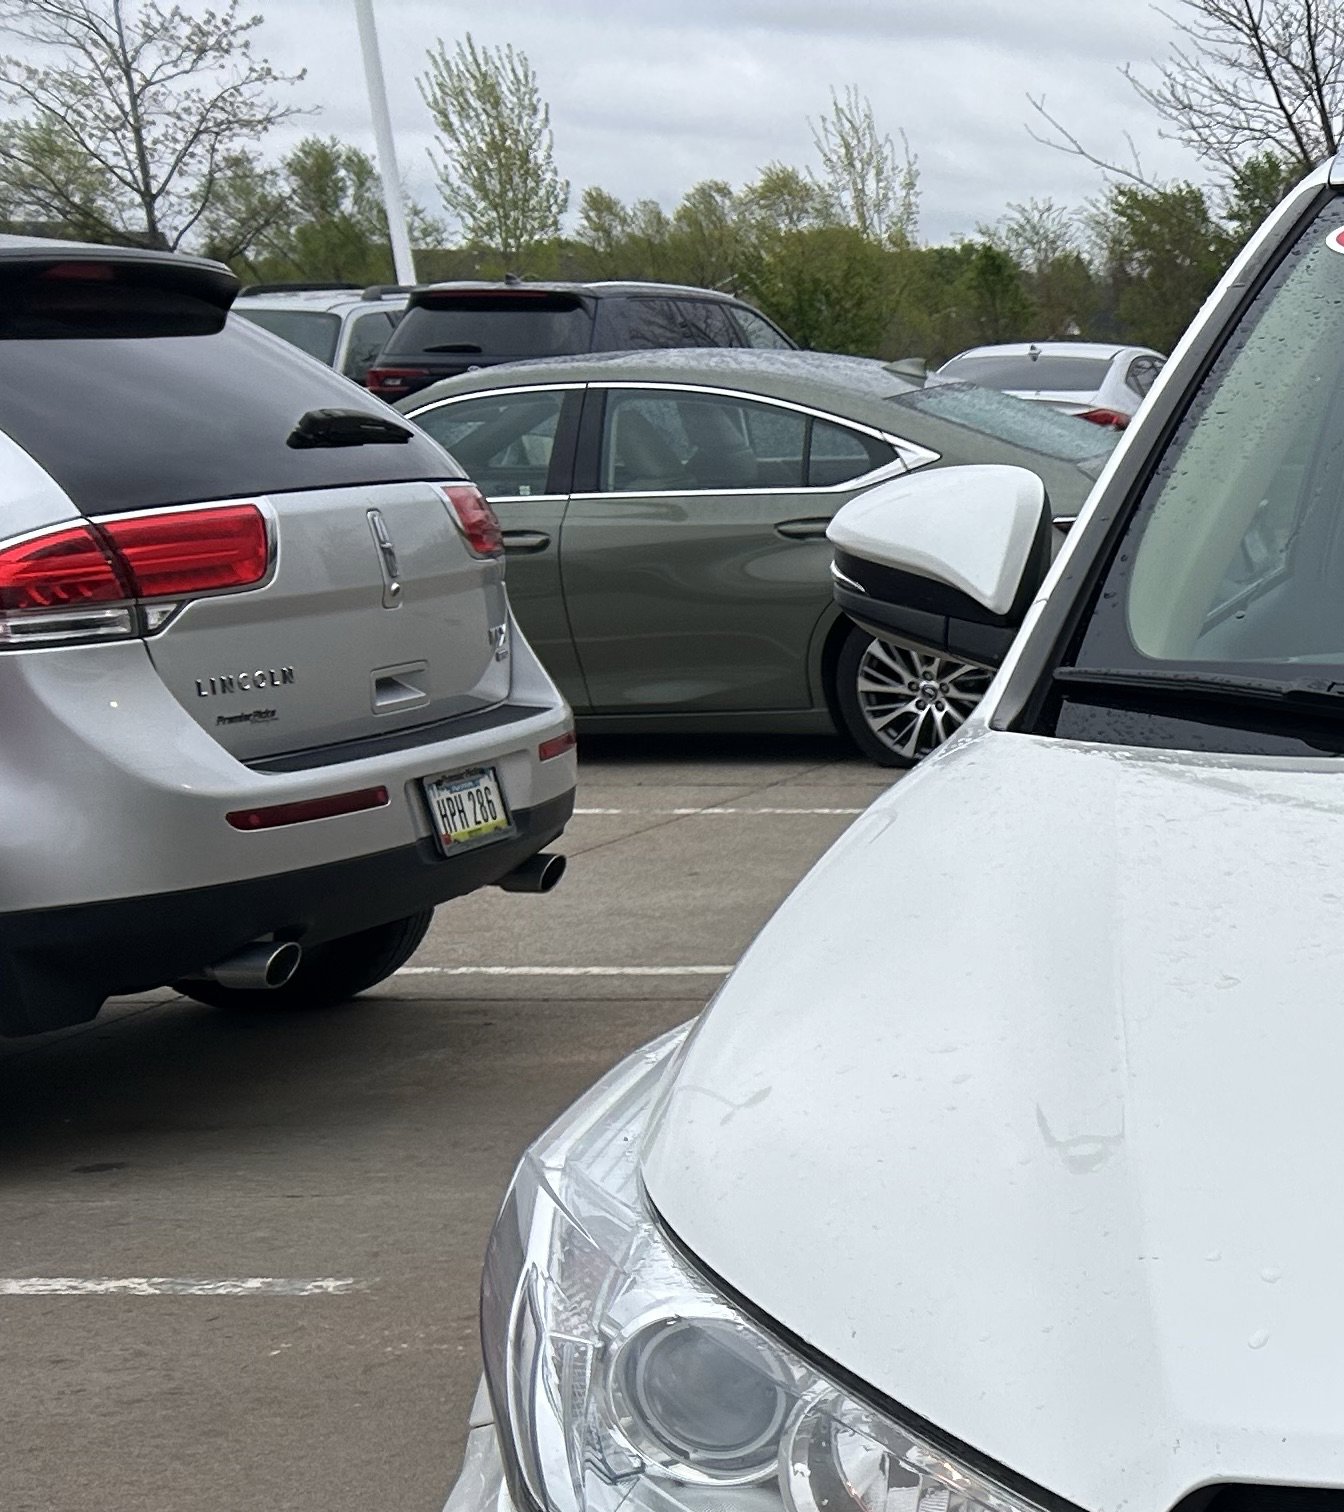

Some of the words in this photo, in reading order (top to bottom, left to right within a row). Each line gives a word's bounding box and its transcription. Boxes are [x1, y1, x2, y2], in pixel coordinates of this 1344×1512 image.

[195, 665, 294, 697] LINCOLN
[437, 793, 470, 834] HPH
[467, 785, 497, 826] 286
